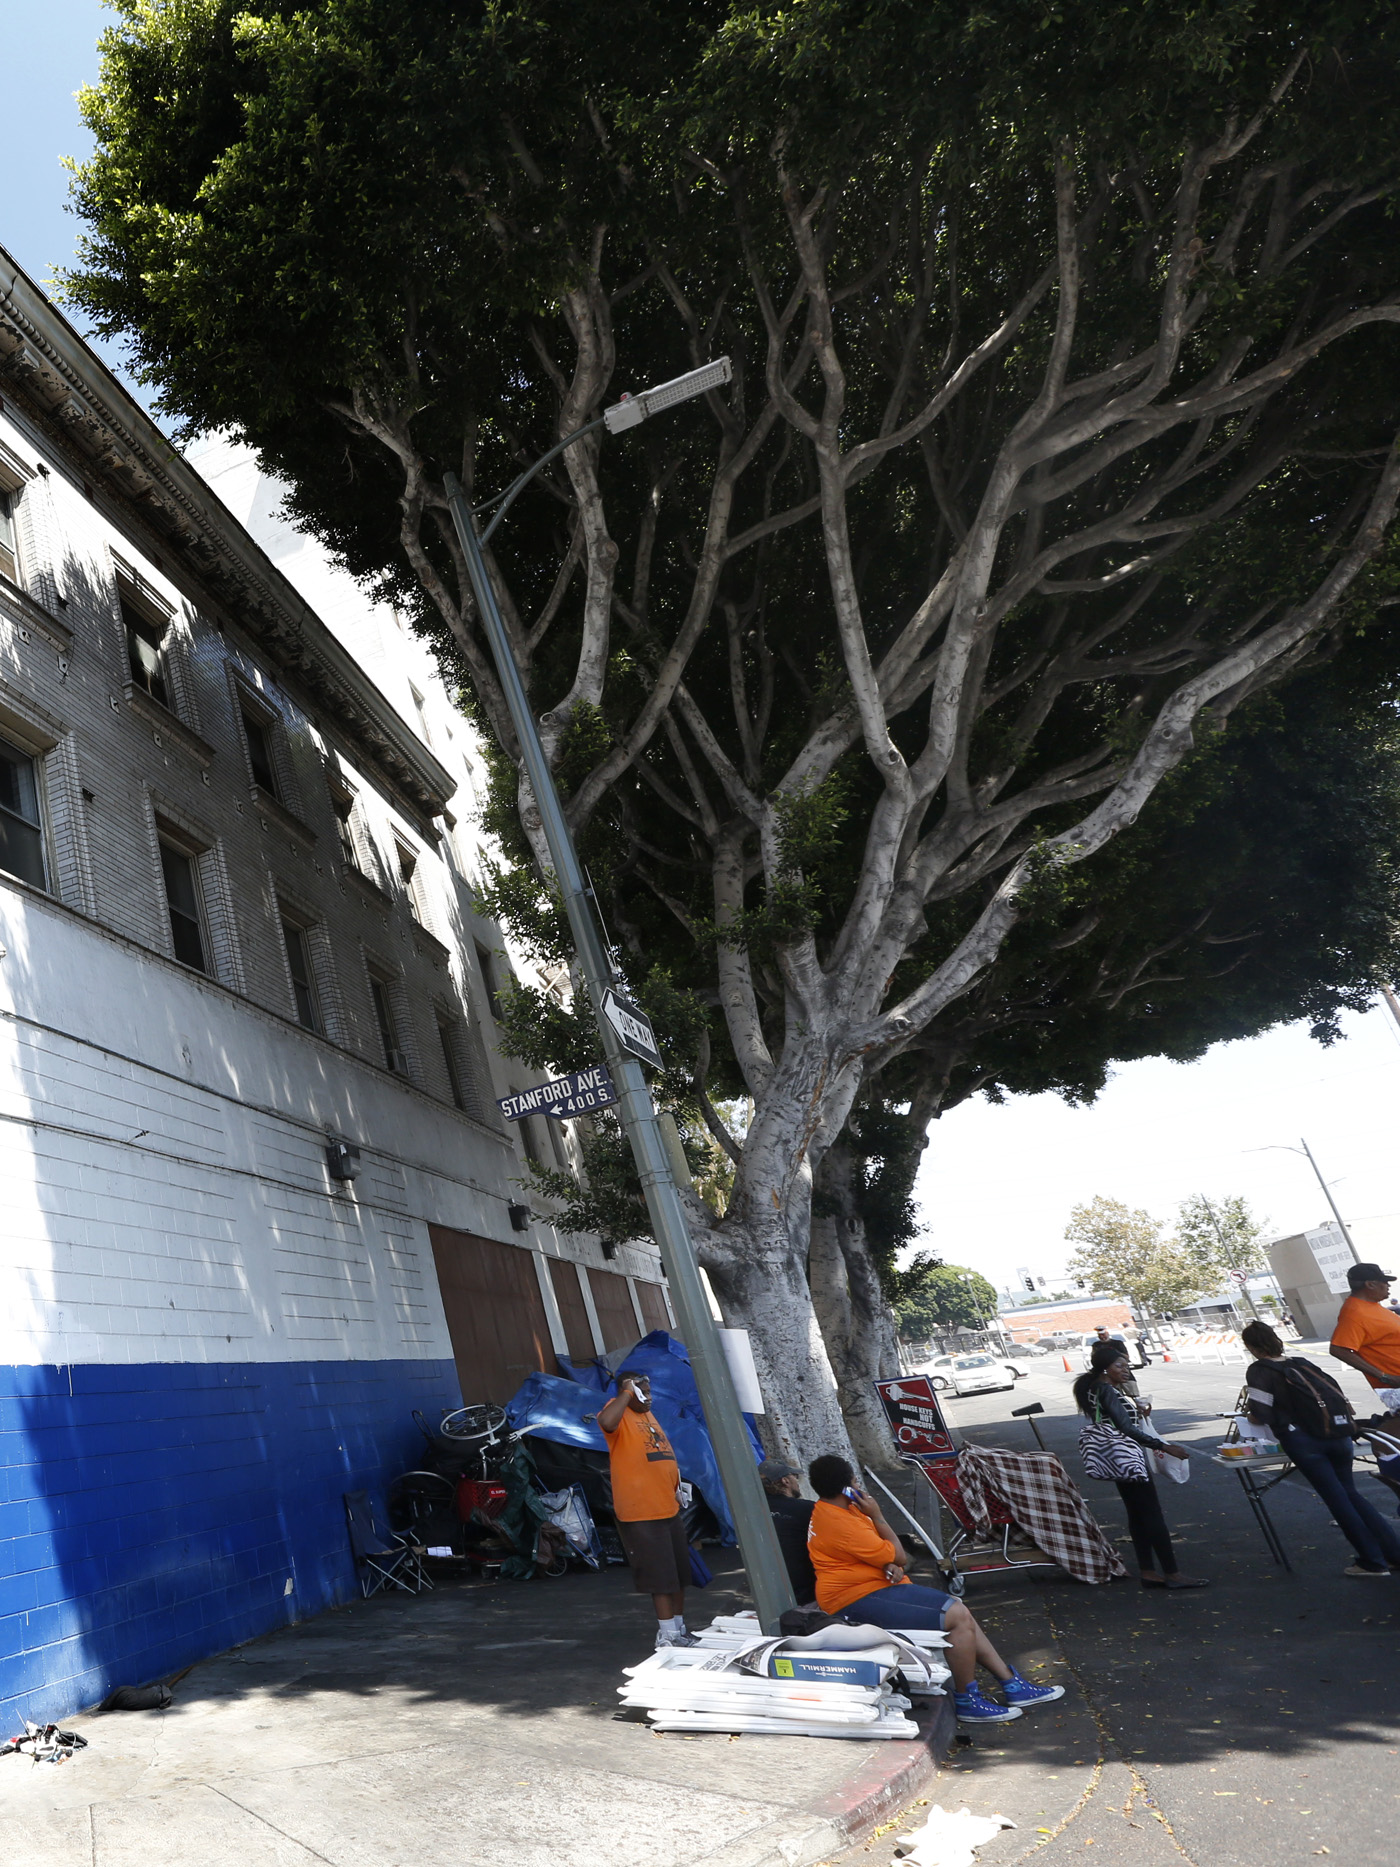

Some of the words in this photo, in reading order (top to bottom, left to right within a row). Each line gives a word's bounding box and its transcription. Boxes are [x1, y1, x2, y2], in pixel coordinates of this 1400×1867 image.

[618, 1011, 638, 1039] ONE
[636, 1023, 653, 1049] WAY
[501, 1080, 572, 1117] STANFORD
[577, 1069, 607, 1092] AVE.
[567, 1093, 595, 1111] 400
[598, 1088, 612, 1102] S.
[899, 1403, 918, 1412] HOUSE
[918, 1406, 933, 1416] KEYS
[902, 1417, 936, 1430] HANDCUFFS
[919, 1414, 933, 1423] NOT
[799, 1664, 856, 1673] HAMMERMILL
